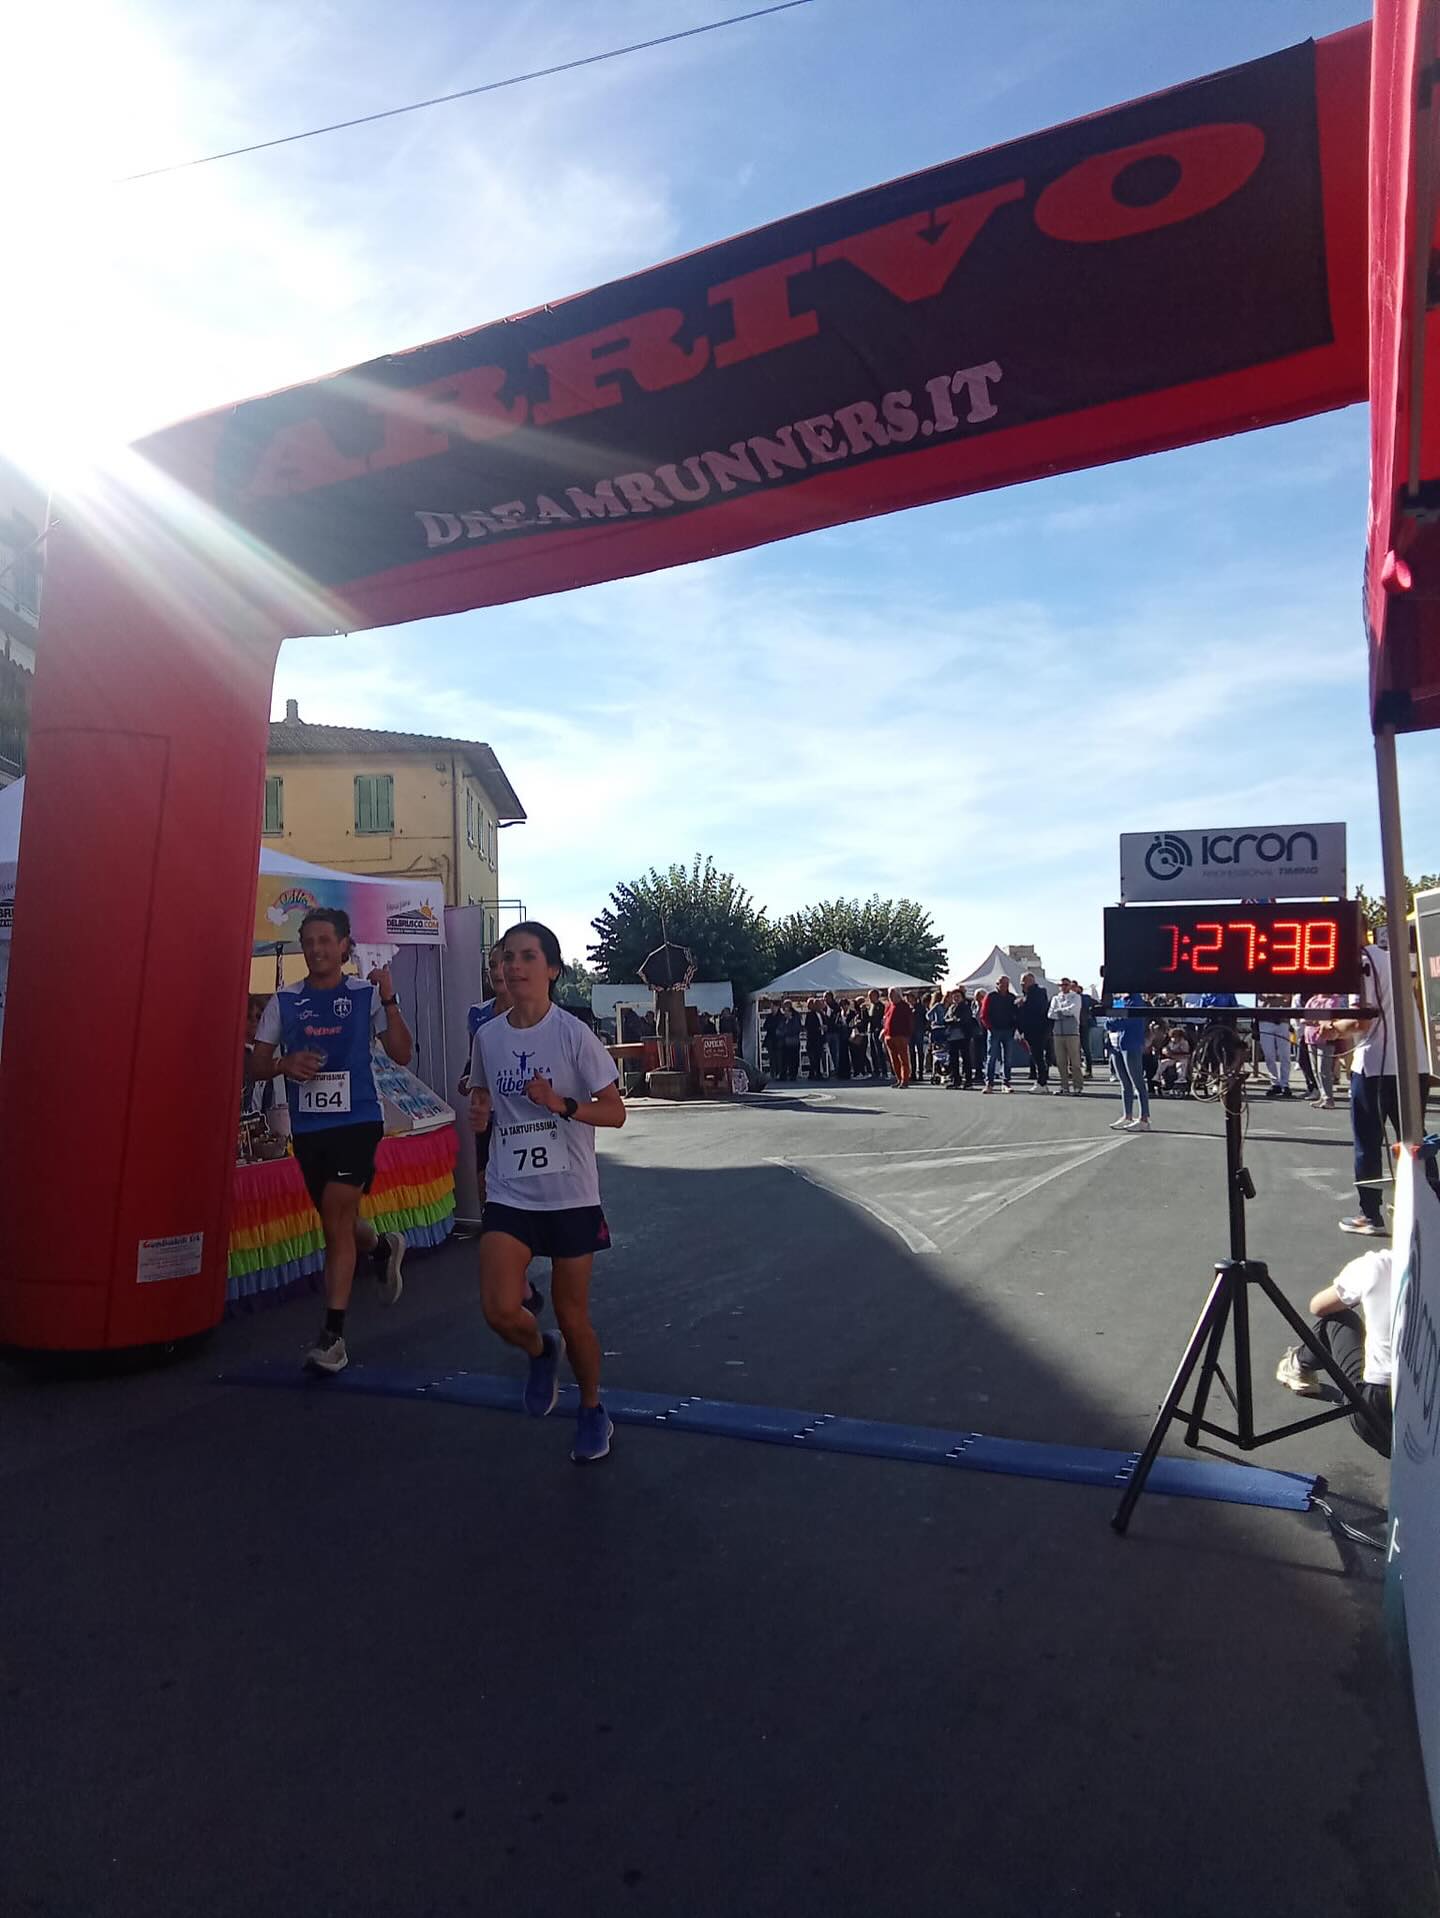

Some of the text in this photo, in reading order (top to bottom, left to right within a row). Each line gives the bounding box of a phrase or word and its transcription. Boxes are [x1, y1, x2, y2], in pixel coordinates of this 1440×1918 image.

[244, 121, 1266, 502] ARRIVO
[415, 360, 1002, 548] DREAMRUNNERS.IT
[304, 1091, 343, 1108] 164
[513, 1146, 549, 1171] 78
